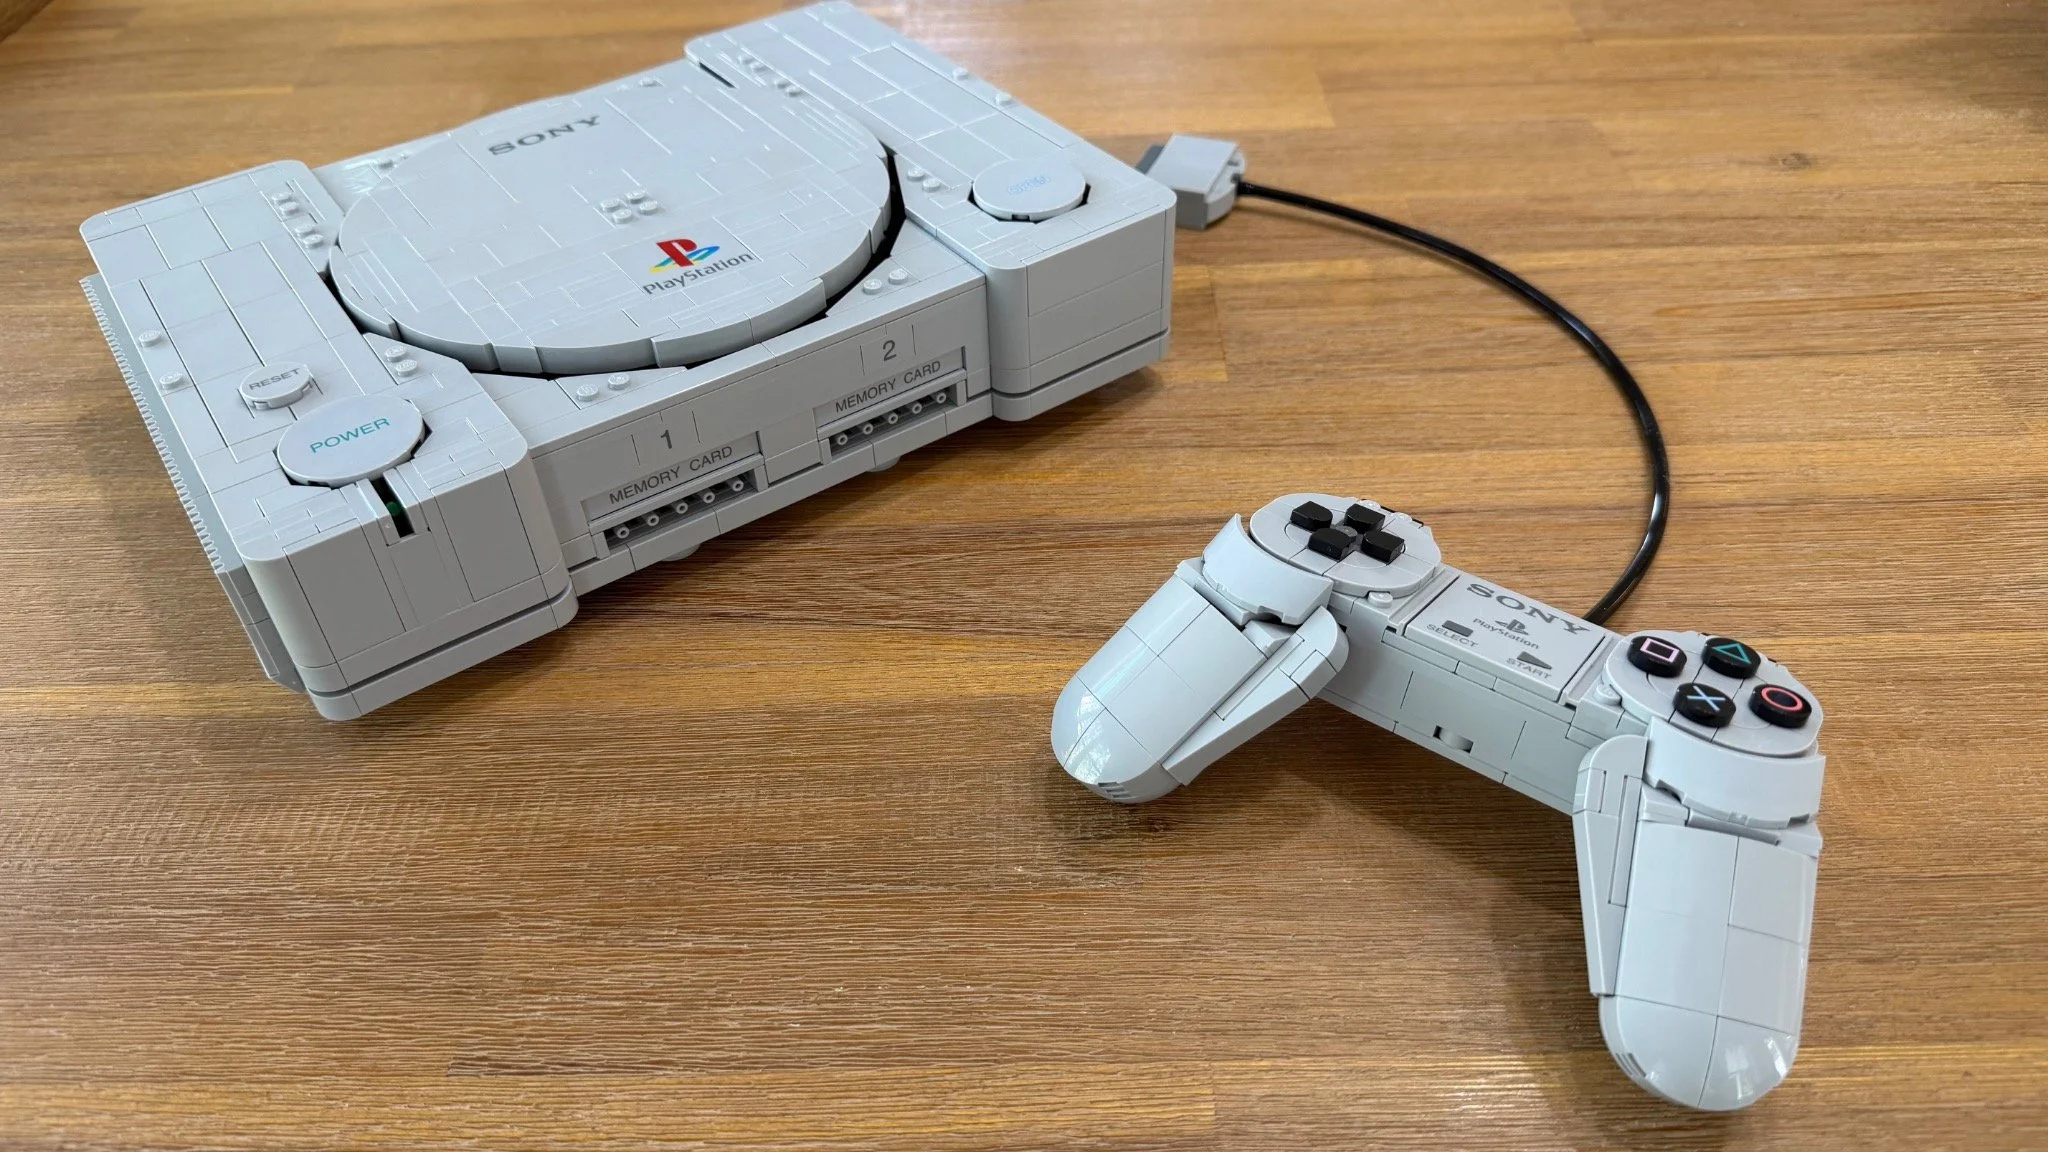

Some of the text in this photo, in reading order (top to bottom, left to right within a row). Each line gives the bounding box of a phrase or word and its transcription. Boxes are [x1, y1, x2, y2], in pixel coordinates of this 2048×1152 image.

[488, 115, 600, 156] SONY
[642, 251, 754, 295] PlayStation
[882, 339, 897, 362] 2
[248, 367, 301, 390] RESET
[835, 360, 941, 413] MEMORY CARD
[309, 417, 391, 454] POWER
[660, 429, 673, 449] 1
[609, 446, 733, 504] MEMORY CARD
[1466, 583, 1591, 635] SONY
[1426, 623, 1479, 648] SELECT
[1472, 618, 1539, 650] PlayStation
[1506, 657, 1553, 680] START
